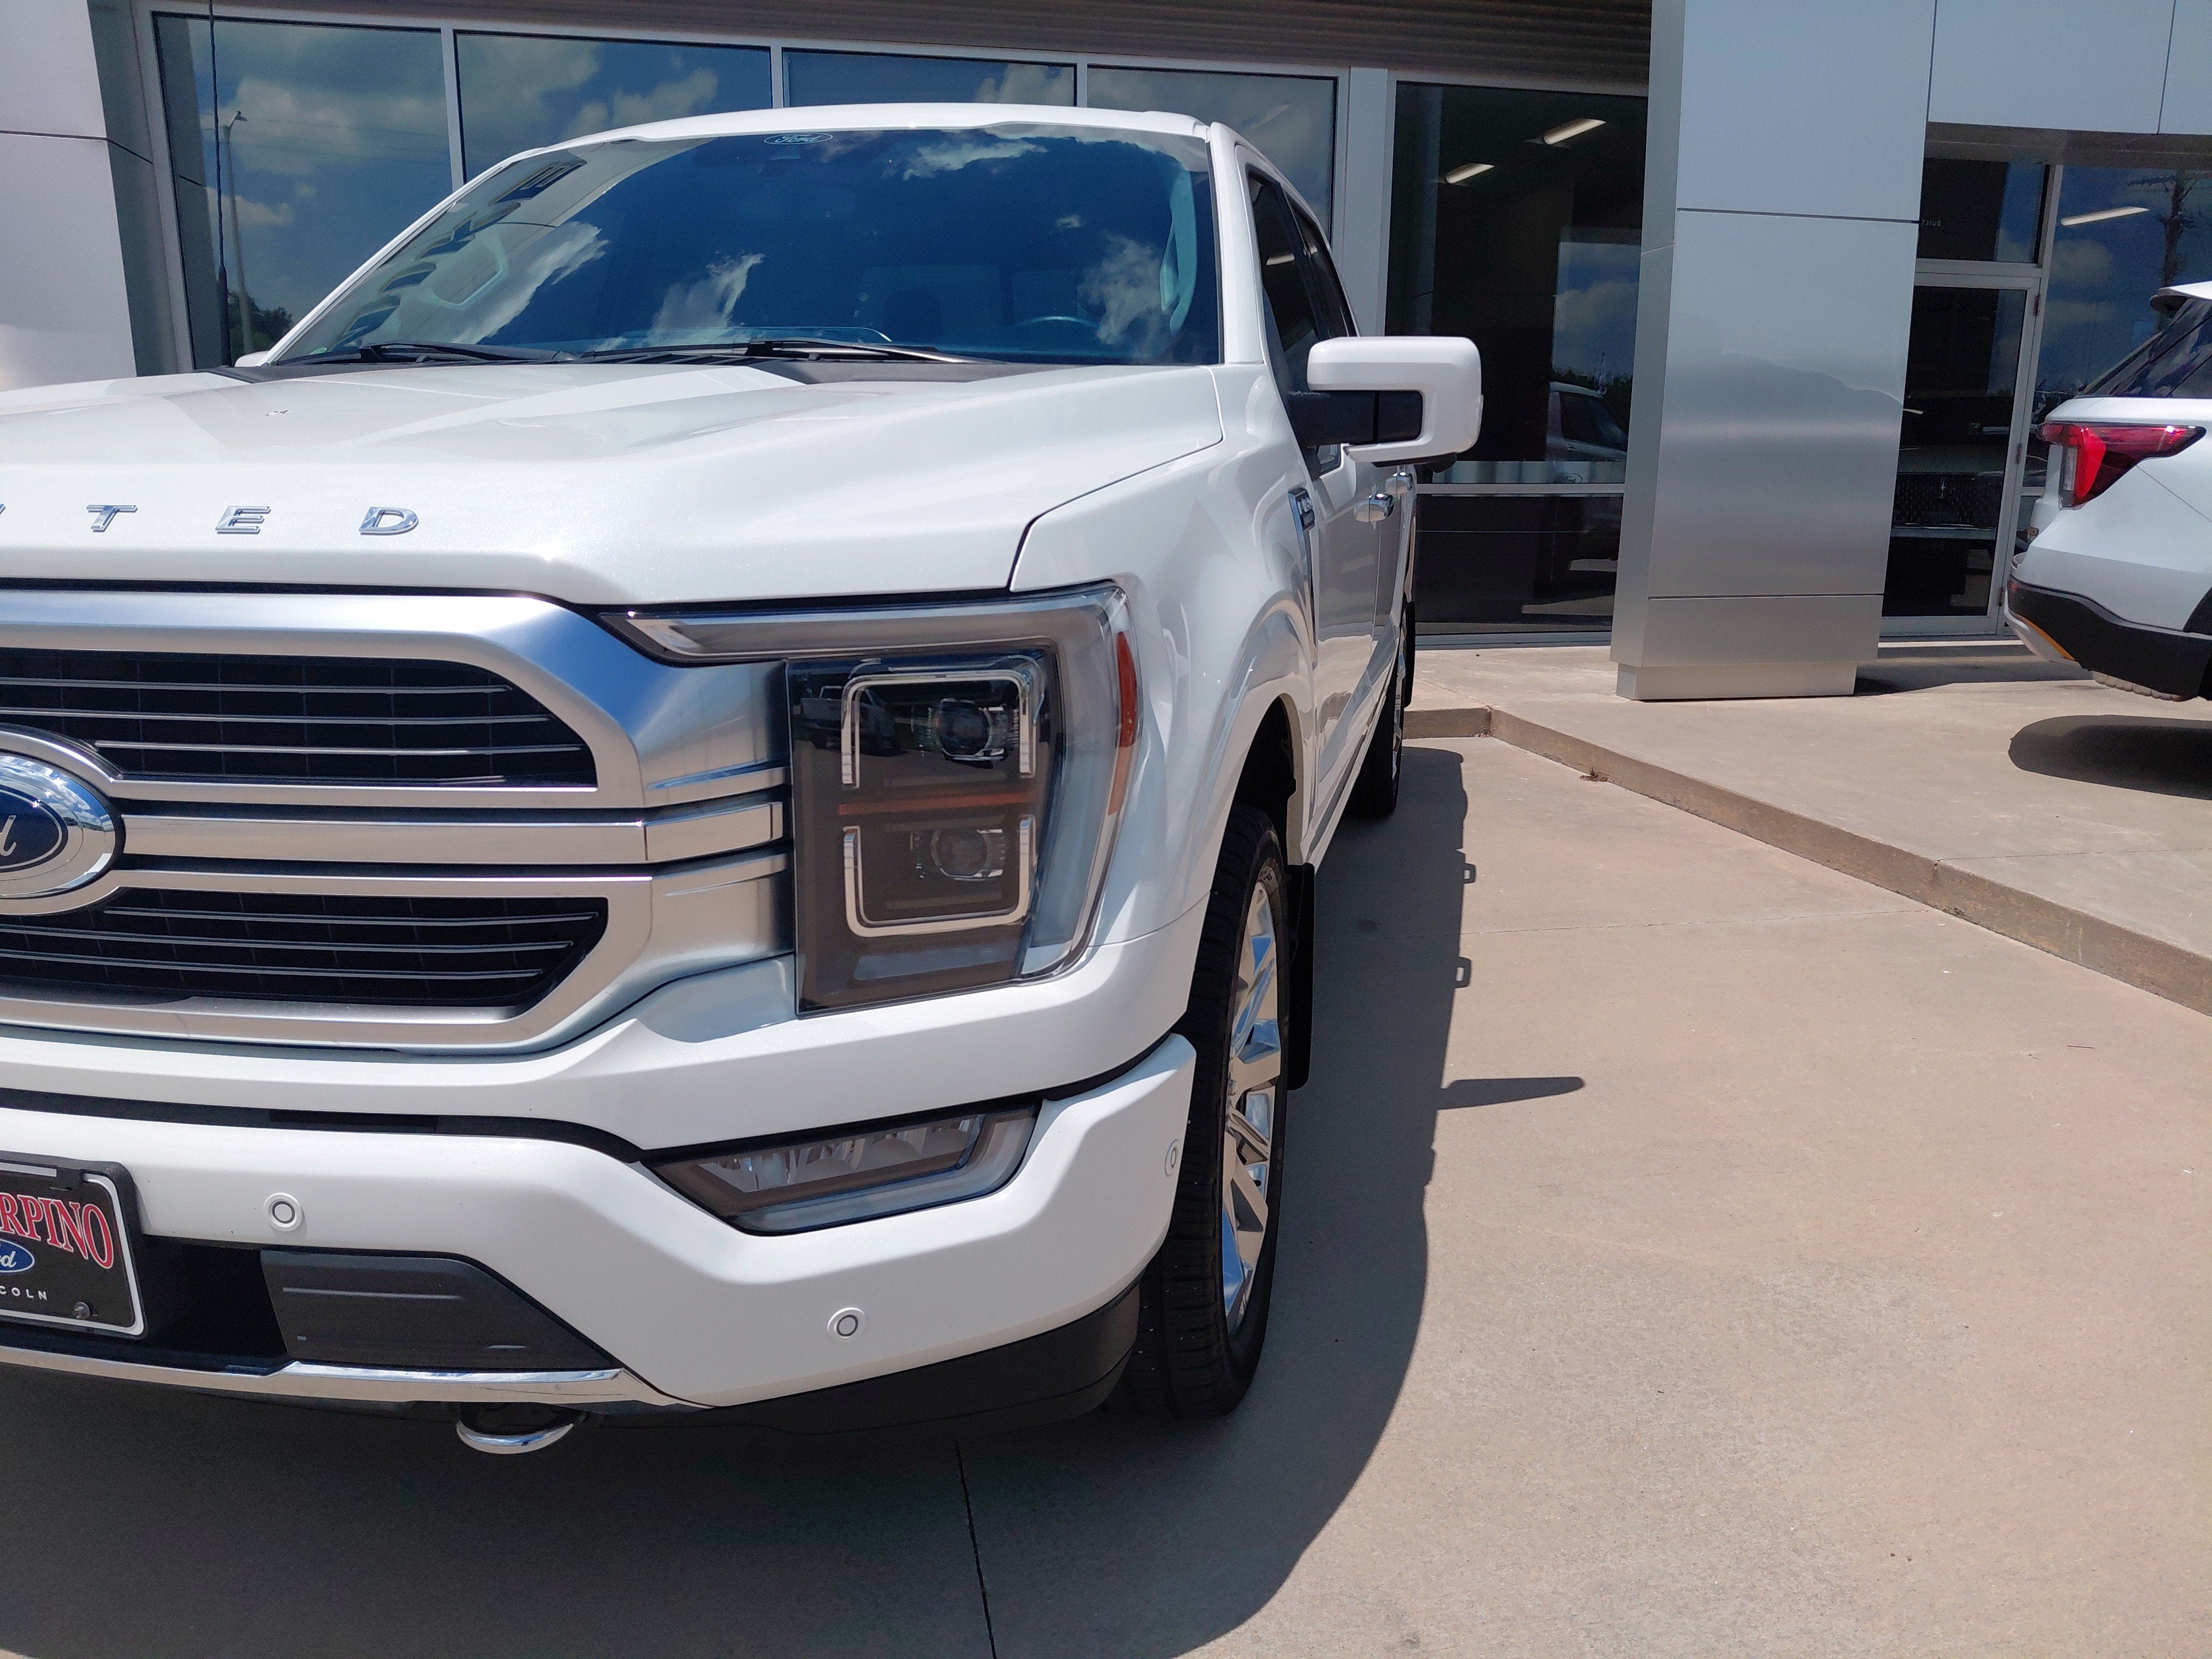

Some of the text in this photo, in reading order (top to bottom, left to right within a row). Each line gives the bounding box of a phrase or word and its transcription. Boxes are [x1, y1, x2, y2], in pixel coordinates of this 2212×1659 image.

[774, 134, 822, 143] Ford
[0, 503, 419, 536] TED
[0, 1192, 114, 1269] RPINO
